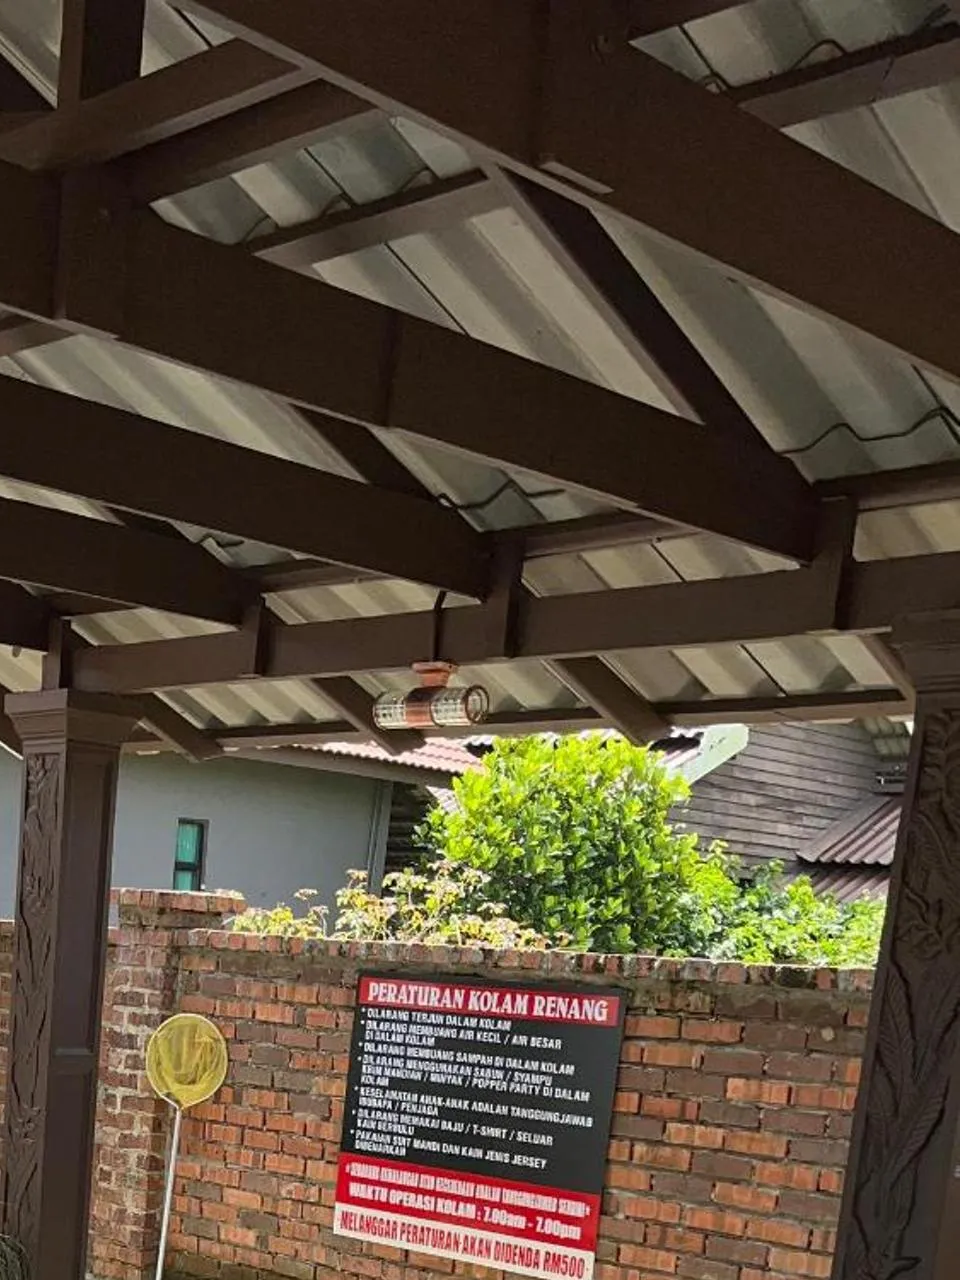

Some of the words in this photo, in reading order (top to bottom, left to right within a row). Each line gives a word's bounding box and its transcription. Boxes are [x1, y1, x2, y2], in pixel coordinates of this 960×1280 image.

[368, 982, 466, 1008] PERATURAN
[468, 990, 529, 1014] KOLAM
[533, 995, 608, 1021] RENANG
[368, 1008, 409, 1020] DILARANG
[412, 1013, 444, 1023] TERJUN
[446, 1016, 477, 1026] DALAM
[479, 1019, 511, 1029] KOLAM
[366, 1021, 407, 1032] DILARANG
[409, 1025, 457, 1038] MEMBUANG
[459, 1030, 474, 1039] AIR
[476, 1032, 501, 1042] KECIL
[512, 1035, 528, 1045] AIR
[530, 1037, 562, 1048] BESAR
[375, 1032, 404, 1042] DALAM
[405, 1035, 435, 1045] KOLAM
[363, 1055, 404, 1067] DILARANG
[406, 1060, 471, 1075] MENGGUNAKAN
[473, 1068, 504, 1079] SABUN
[513, 1072, 551, 1085] SYAMPU
[364, 1043, 405, 1055] DILARANG
[407, 1047, 454, 1061] MEMBUANG
[456, 1053, 493, 1065] SAMPAH
[506, 1058, 538, 1070] DALAM
[540, 1062, 575, 1074] KOLAM
[361, 1075, 389, 1085] KOLAM
[472, 1078, 507, 1090] POPPER
[509, 1083, 540, 1095] PARTY
[555, 1088, 590, 1101] DALAM
[360, 1087, 418, 1102] KESELAMATAN
[419, 1095, 469, 1109] ANAK-ANAK
[471, 1102, 508, 1115] ADALAH
[511, 1107, 593, 1126] TANGGUNGJAWAB
[401, 1102, 438, 1115] PENJAGA
[357, 1118, 376, 1129] KAIN
[358, 1109, 398, 1122] DILARANG
[400, 1115, 439, 1128] MEMAKAI
[441, 1120, 464, 1132] BAJU
[472, 1125, 507, 1138] T-SHIRT
[516, 1131, 553, 1145] SELUAR
[354, 1140, 406, 1156] DIBENARKAN
[356, 1130, 392, 1144] PAKAIAN
[413, 1139, 440, 1152] MANDI
[442, 1144, 459, 1155] DAN
[461, 1146, 483, 1158] KAIN
[485, 1150, 510, 1163] JENIS
[512, 1154, 547, 1169] JERSEY
[349, 1183, 387, 1202] WAKTU
[389, 1190, 434, 1211] OPERASI
[436, 1198, 476, 1219] KOLAM
[341, 1212, 399, 1240] MELANGGAR
[399, 1223, 461, 1253] PERATURAN
[462, 1235, 494, 1259] AKAN
[494, 1241, 541, 1269] DIDENDA
[543, 1251, 585, 1278] RM500
